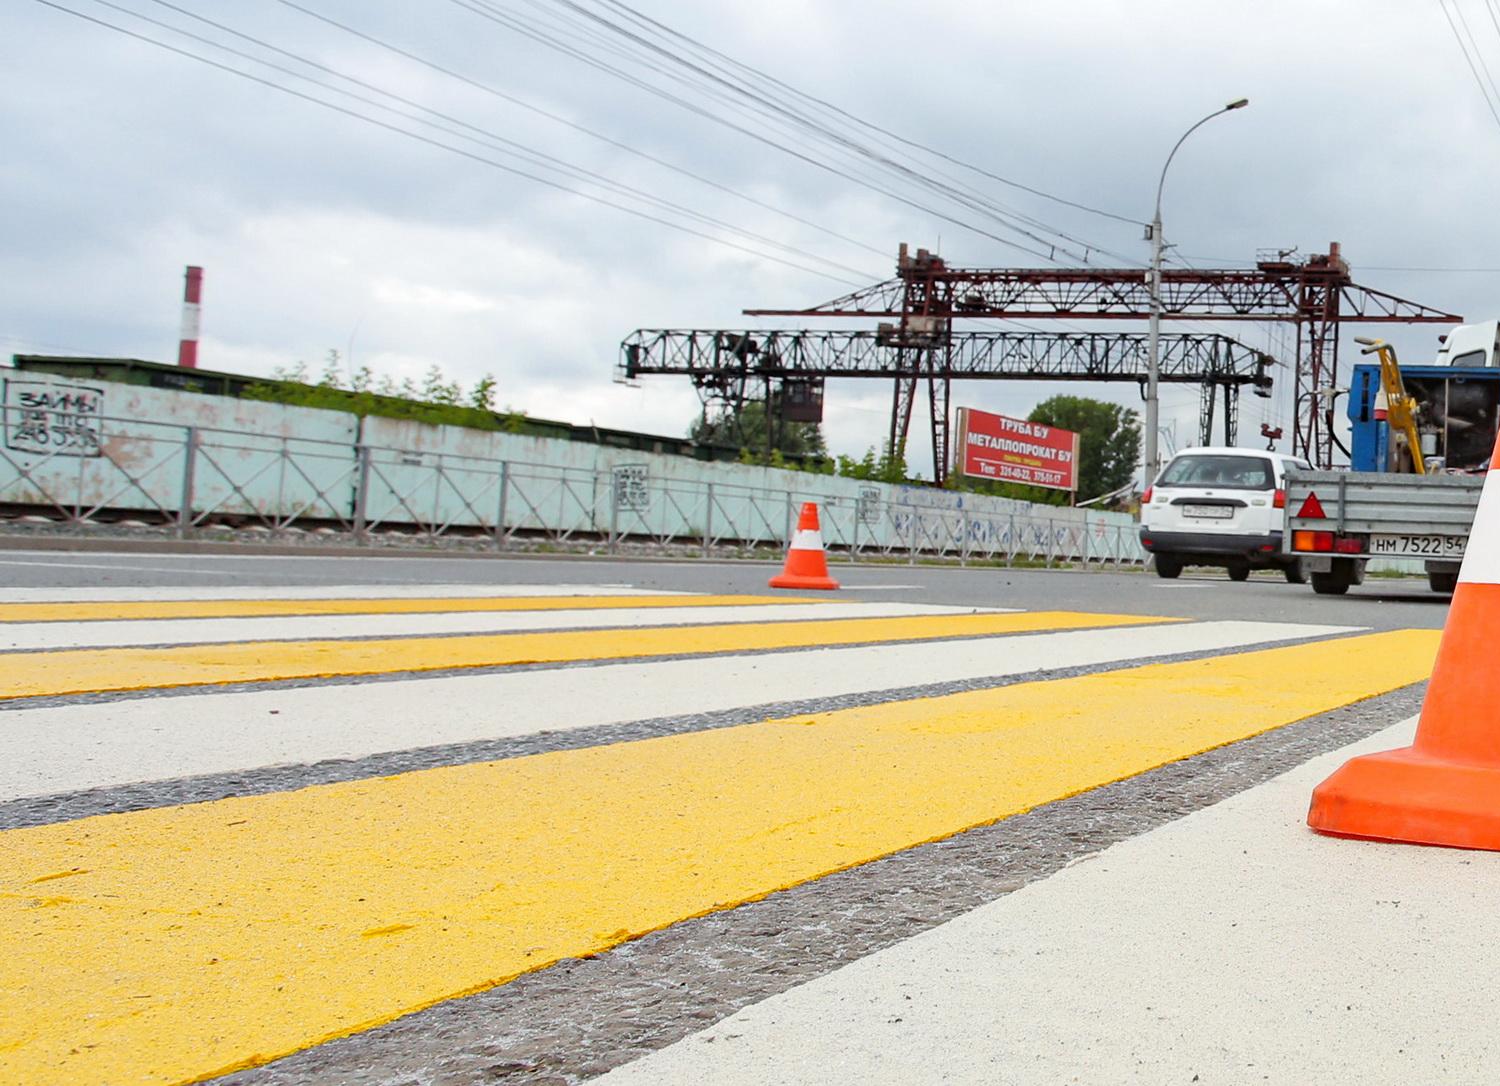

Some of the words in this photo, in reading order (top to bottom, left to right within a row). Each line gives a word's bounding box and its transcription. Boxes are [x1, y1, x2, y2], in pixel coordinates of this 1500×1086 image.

[1000, 418, 1032, 436] ТРУБА
[967, 432, 1057, 459] МЕТАЛЛОПРОКАТ
[1376, 539, 1397, 552] НМ
[1400, 536, 1441, 553] 7522
[1446, 537, 1462, 550] 54
